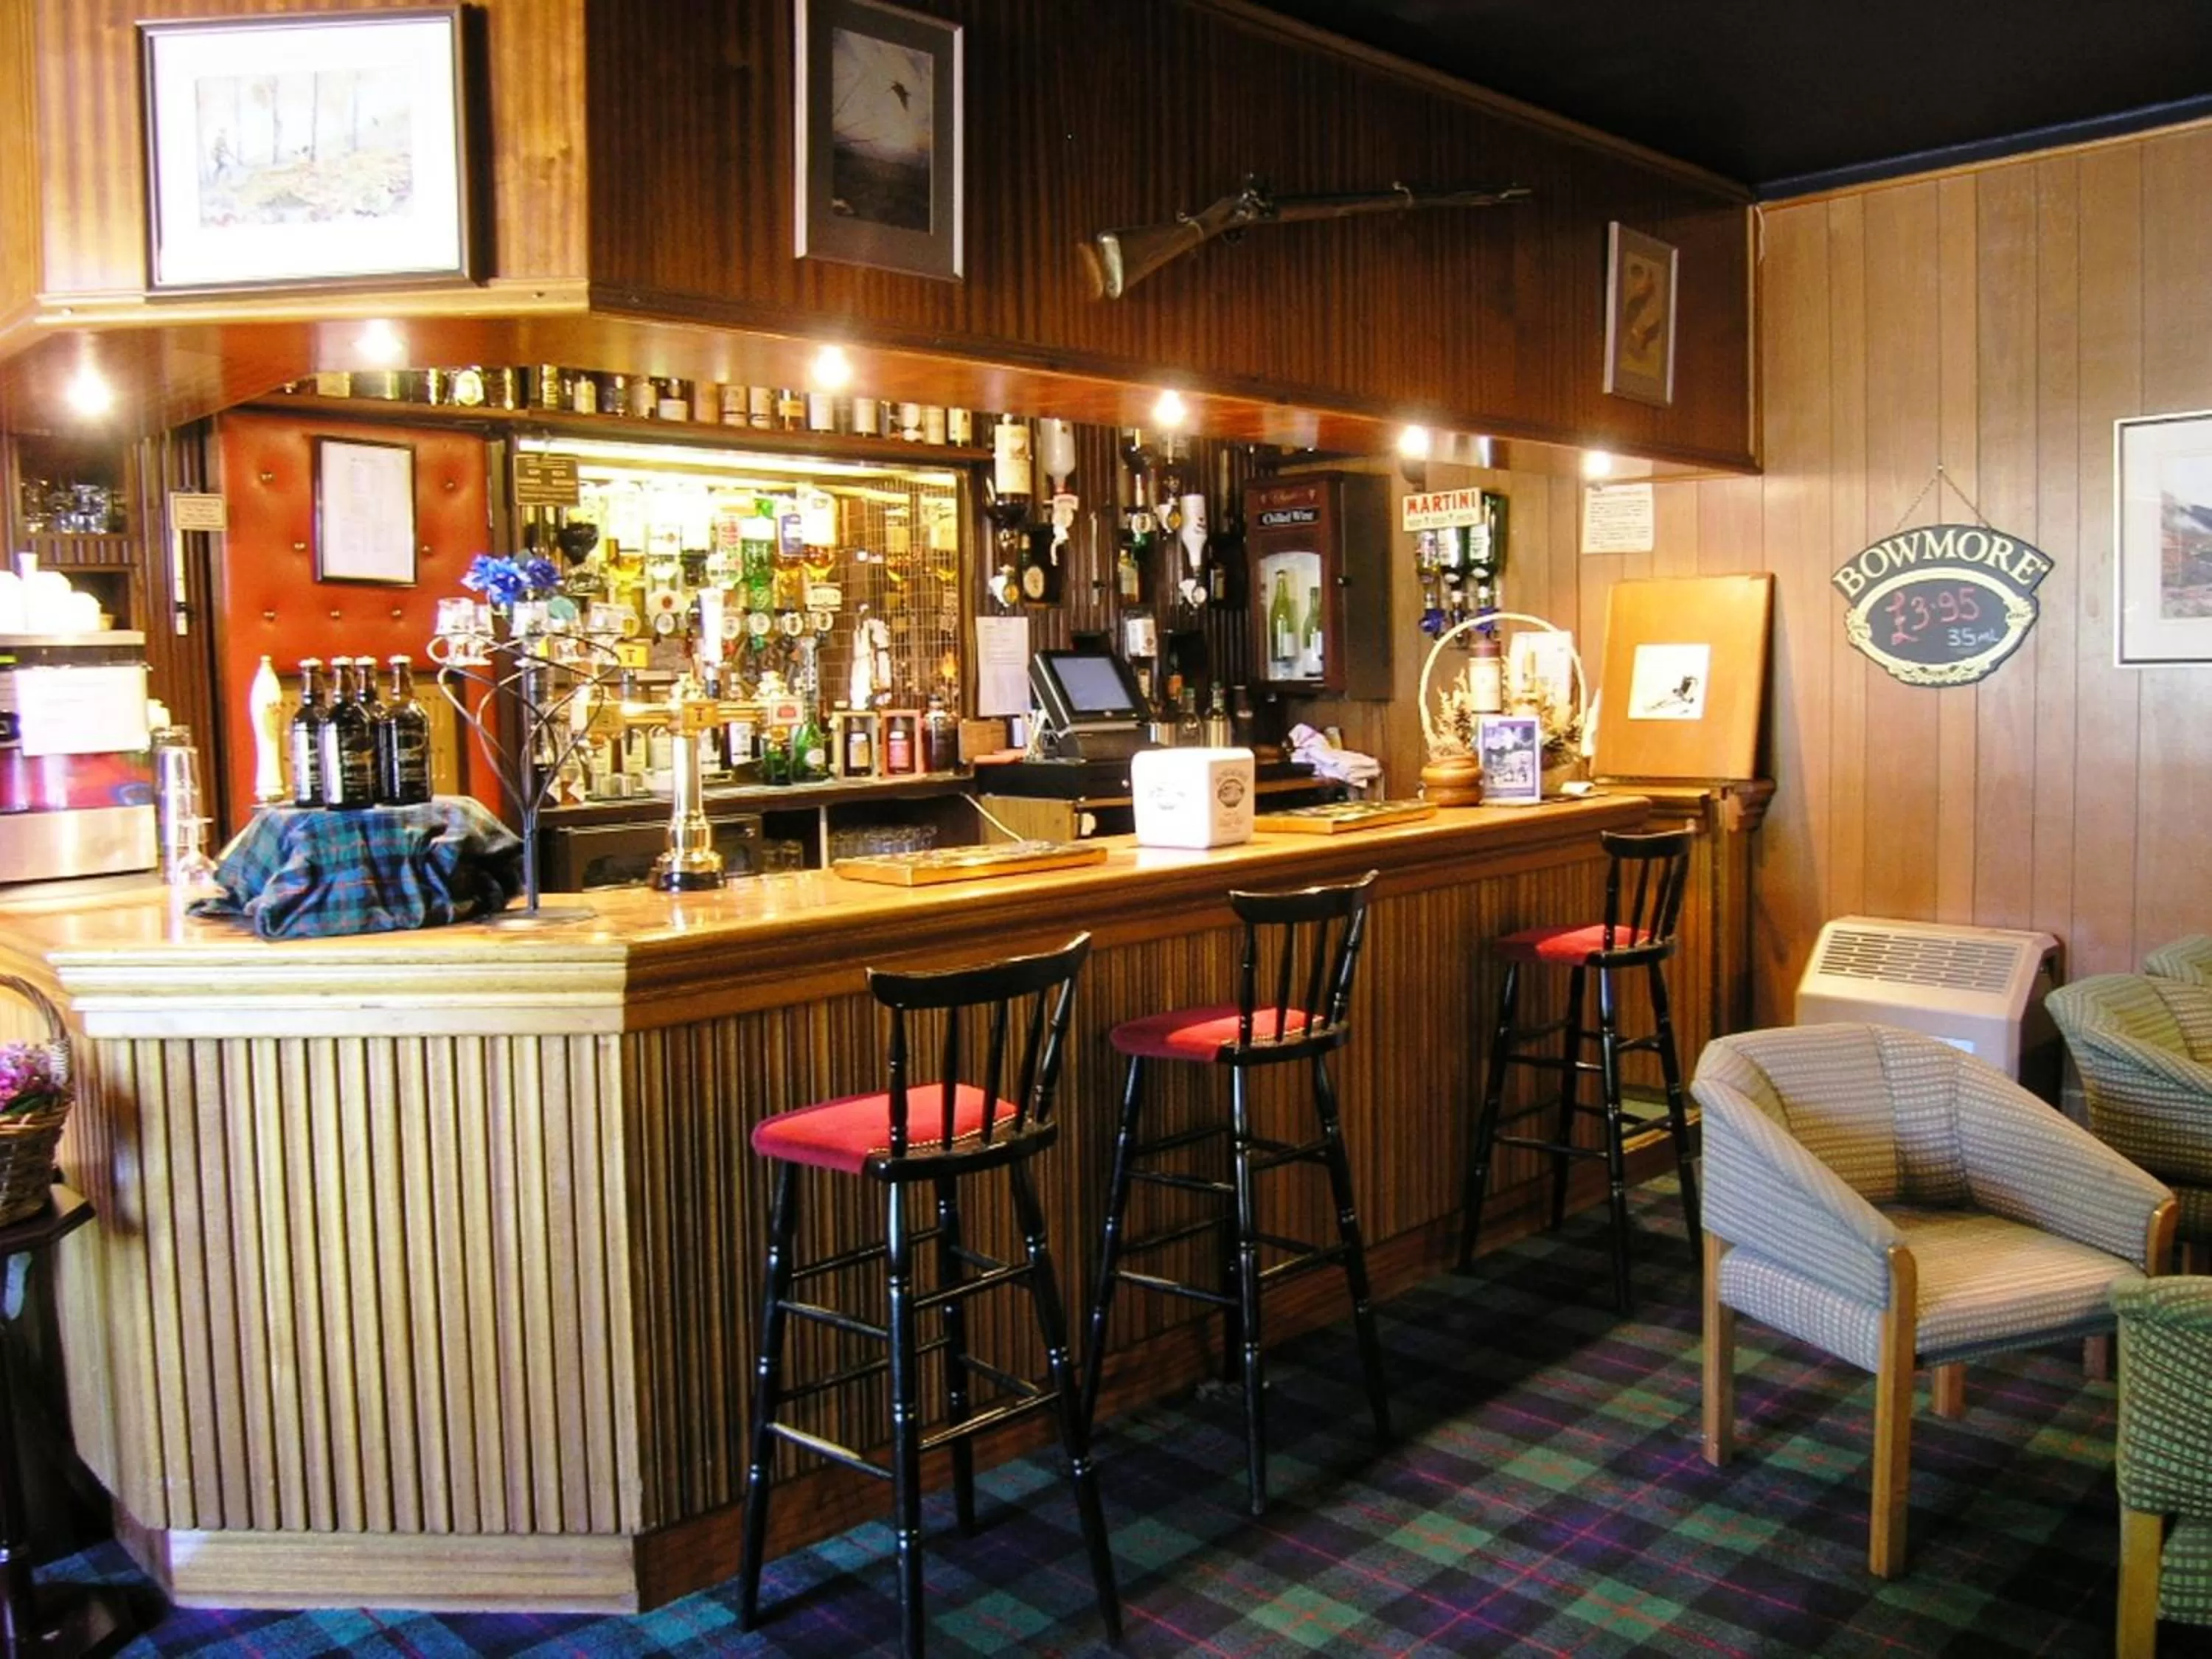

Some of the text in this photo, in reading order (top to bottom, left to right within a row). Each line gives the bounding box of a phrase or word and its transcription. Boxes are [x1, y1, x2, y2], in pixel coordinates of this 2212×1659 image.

[1407, 491, 1475, 515] MARTINI
[1262, 510, 1314, 525] Chilled Wine
[1832, 529, 2034, 597] BOWMORE
